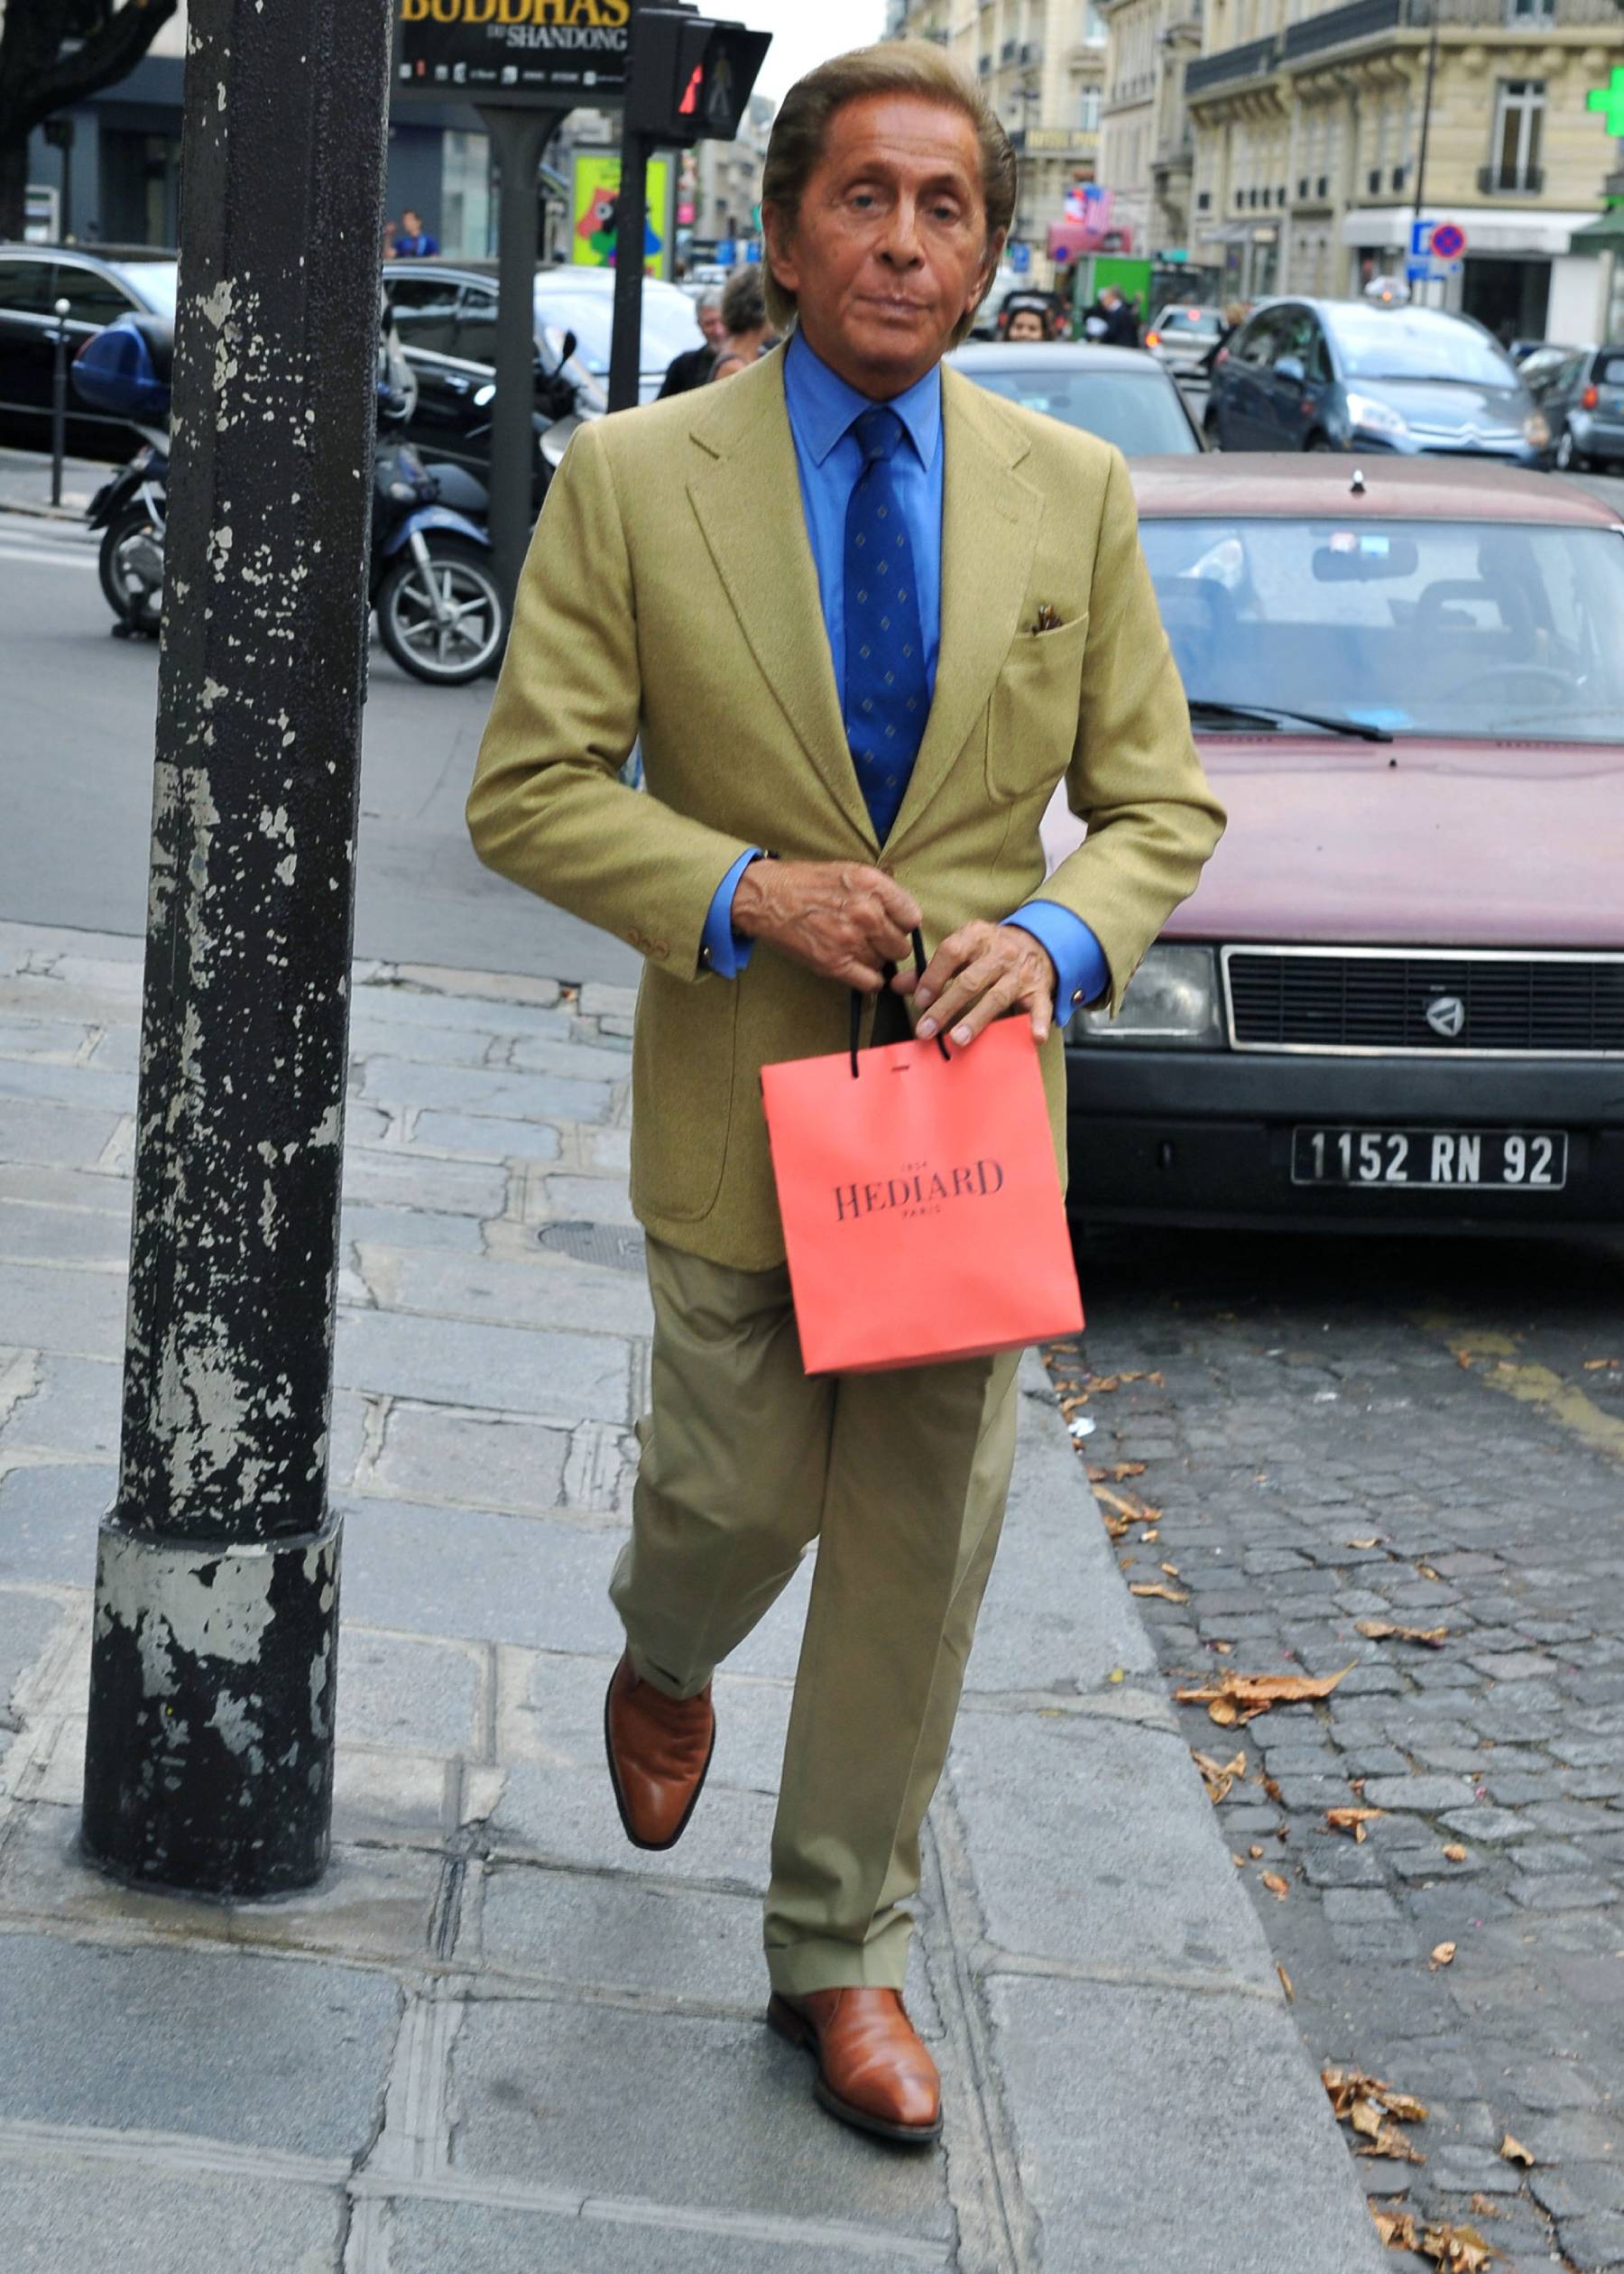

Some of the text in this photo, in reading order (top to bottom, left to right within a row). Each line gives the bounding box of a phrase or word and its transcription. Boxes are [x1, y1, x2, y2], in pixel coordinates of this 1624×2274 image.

[400, 0, 631, 27] BUDDHAS
[506, 26, 629, 51] SHANDONG
[1312, 1132, 1553, 1184] 1152 RN 92
[835, 1159, 1003, 1222] HEDIARD
[902, 1204, 942, 1221] PARIS
